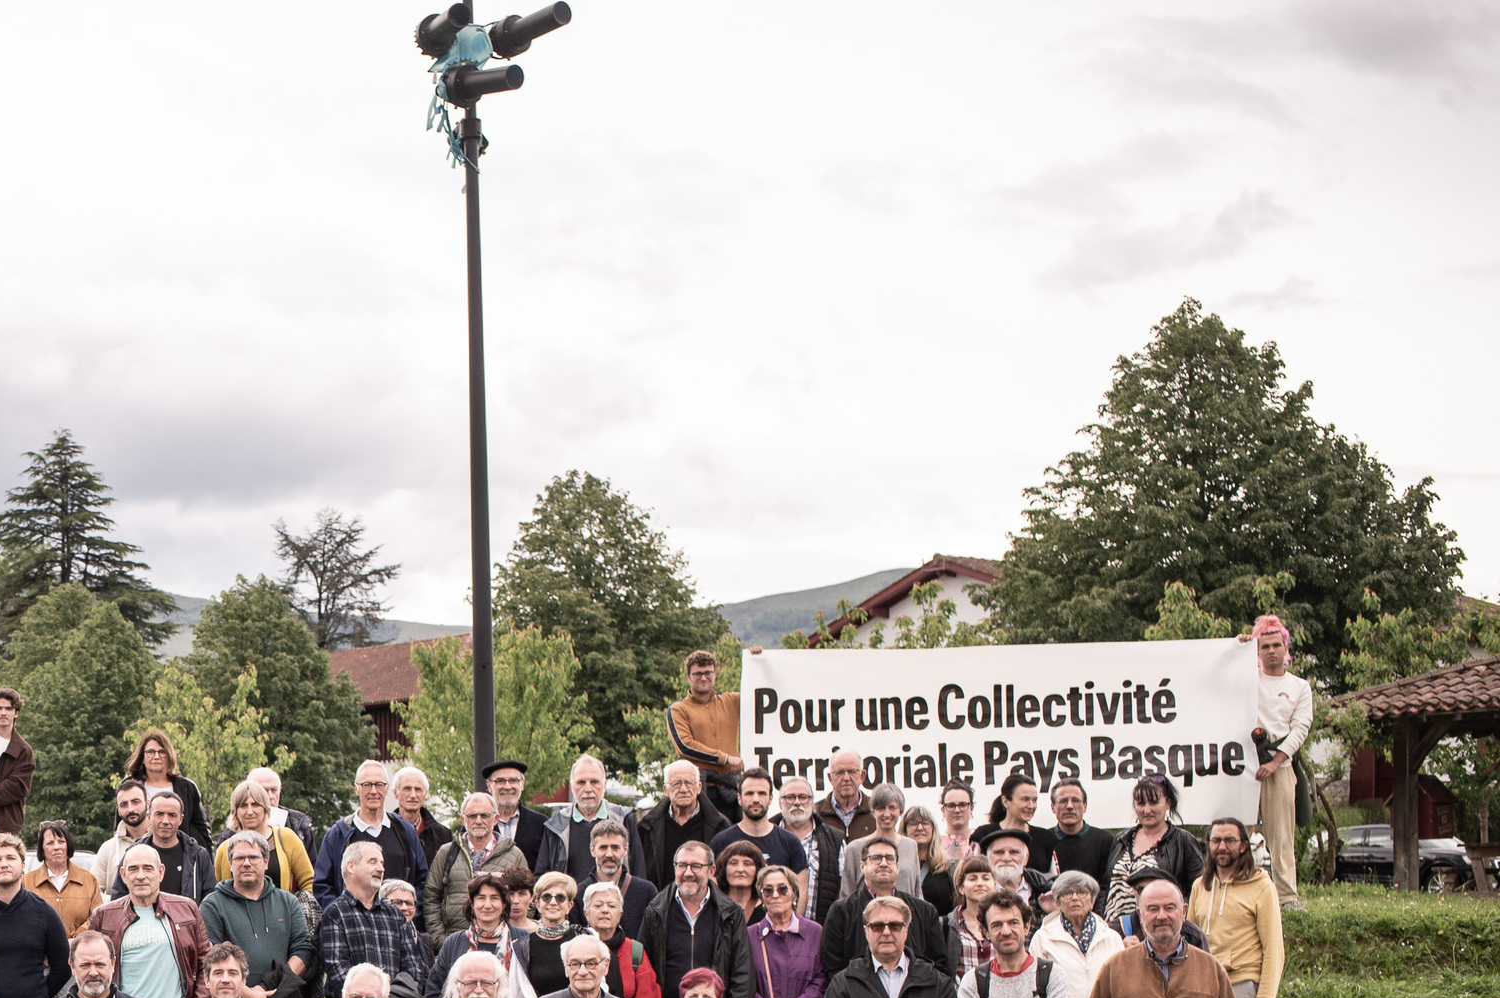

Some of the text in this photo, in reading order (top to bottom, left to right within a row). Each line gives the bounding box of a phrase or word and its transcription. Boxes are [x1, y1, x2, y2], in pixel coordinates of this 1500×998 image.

[755, 679, 1176, 734] Pour une Collectivité
[755, 737, 1245, 793] Terroriale Pays Basque
